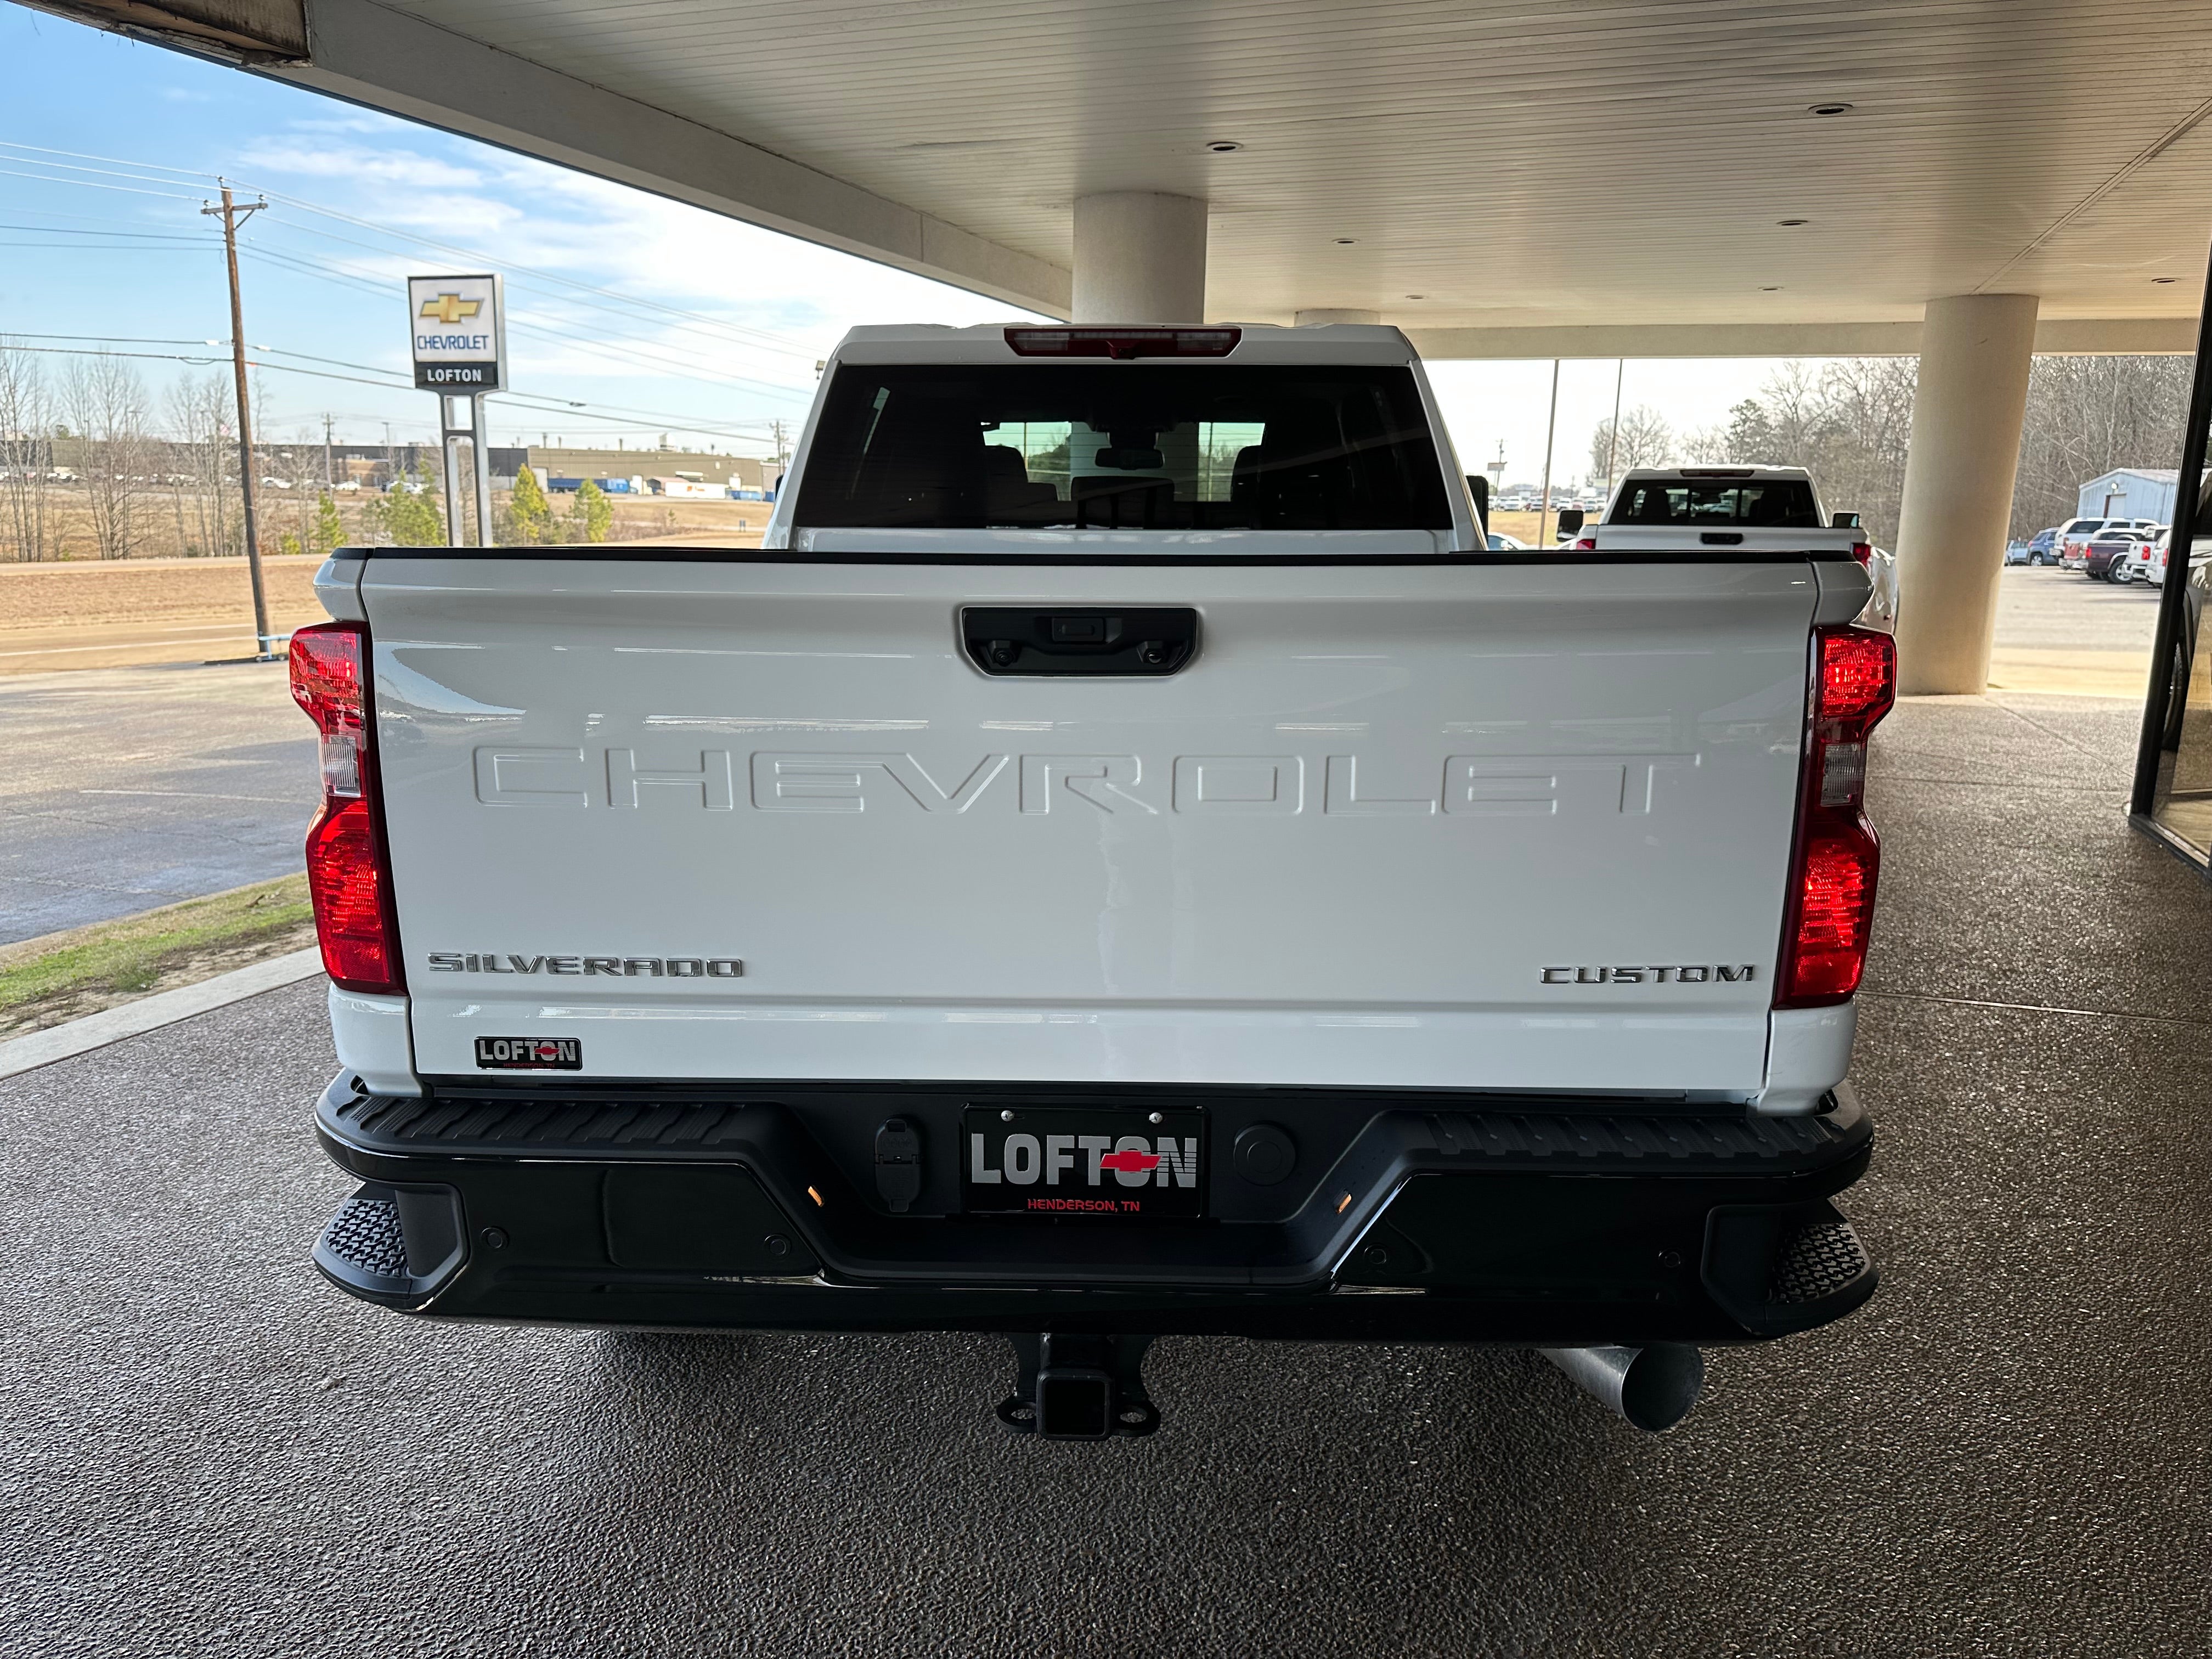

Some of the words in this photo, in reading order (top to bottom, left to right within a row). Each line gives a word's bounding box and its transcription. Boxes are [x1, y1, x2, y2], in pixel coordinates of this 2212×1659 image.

[417, 335, 489, 350] CHEVROLET
[427, 369, 482, 382] LOFTON
[473, 746, 1701, 816] CHEVROLET
[427, 952, 743, 978] SILVERADO
[1539, 964, 1755, 984] CUSTOM
[479, 1040, 576, 1061] LOFTON
[972, 1133, 1197, 1188] LOFTON
[1028, 1198, 1118, 1212] HENDERSON,
[1121, 1200, 1141, 1211] TN
